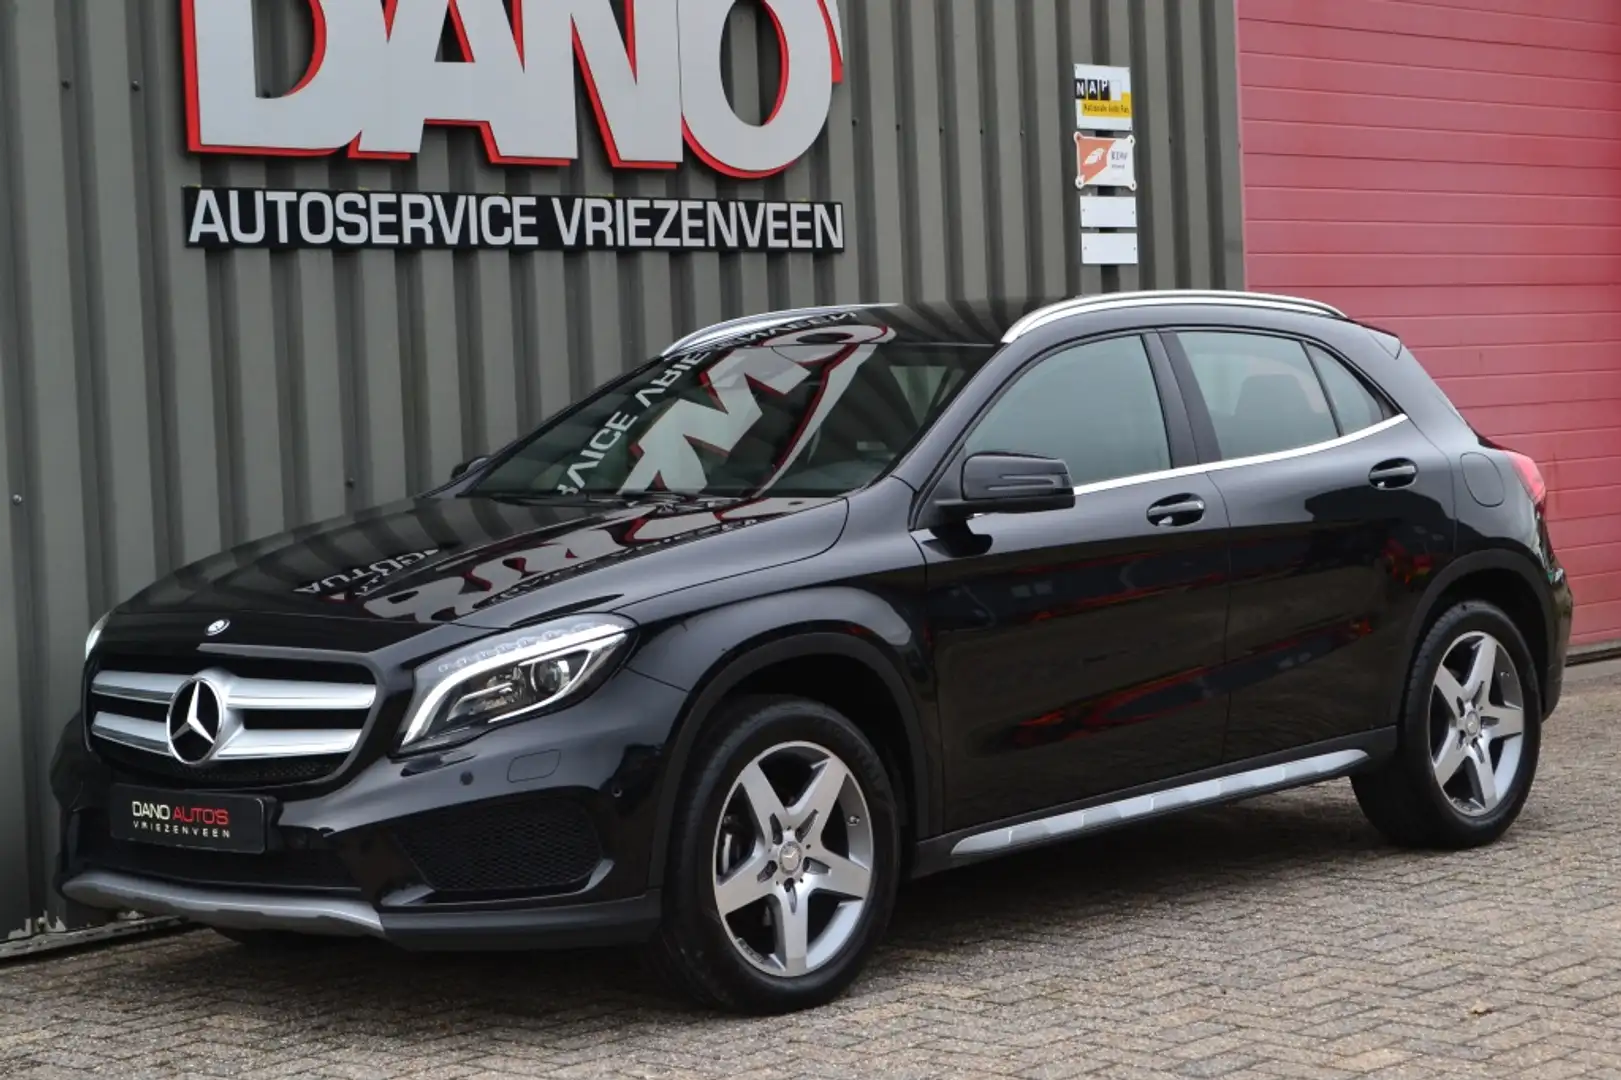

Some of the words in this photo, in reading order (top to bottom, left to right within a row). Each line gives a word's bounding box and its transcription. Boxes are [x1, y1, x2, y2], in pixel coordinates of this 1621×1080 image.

[181, 0, 832, 178] DANO
[1076, 80, 1109, 97] NAP
[189, 189, 539, 245] AUTOSERVICE
[551, 198, 844, 249] VRIEZENVEEN
[132, 801, 171, 820] DANO
[133, 820, 230, 838] VRIEZENVEEN
